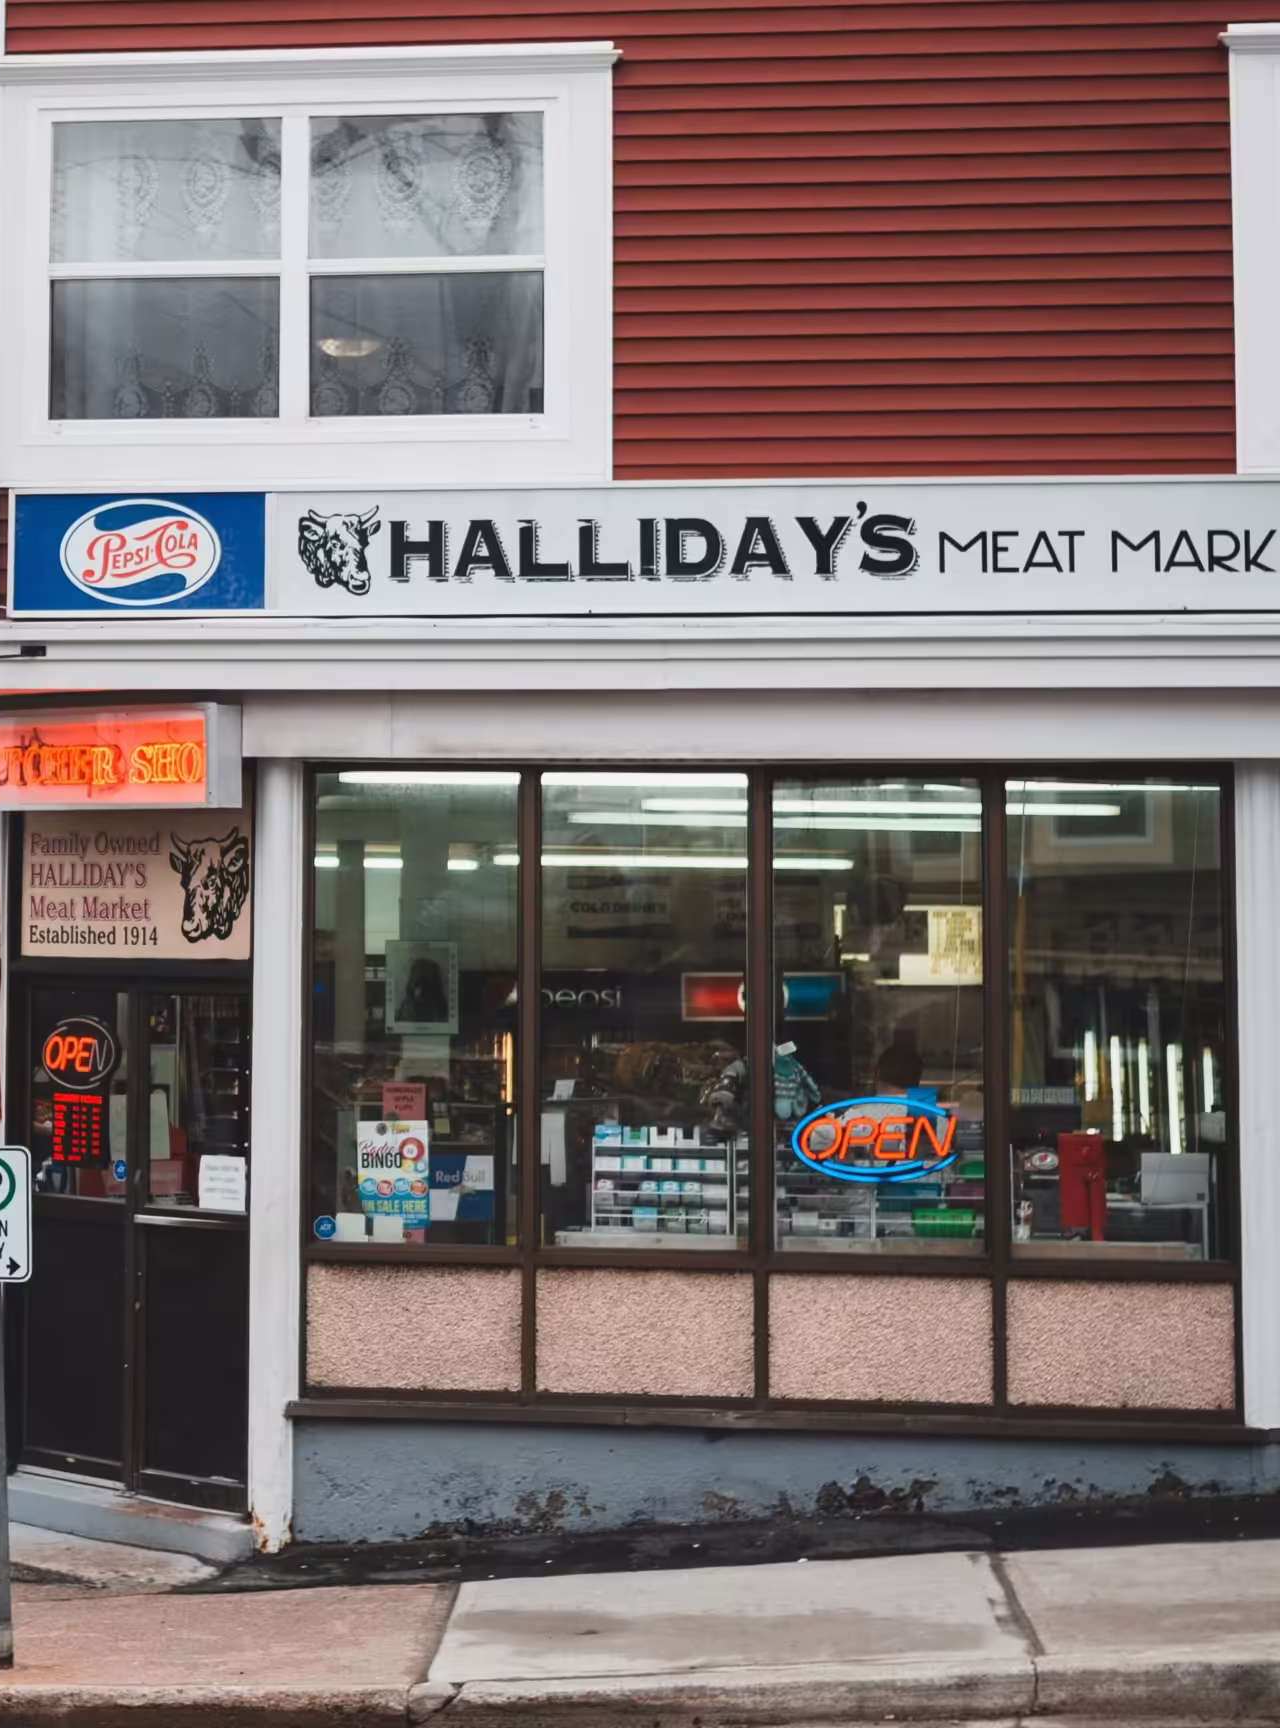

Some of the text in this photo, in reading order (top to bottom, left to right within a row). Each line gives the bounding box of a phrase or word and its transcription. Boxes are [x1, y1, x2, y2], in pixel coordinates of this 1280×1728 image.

[388, 500, 1278, 584] HALLIDAY'S MEAT MARK
[129, 742, 206, 784] SHO
[31, 831, 160, 861] Family Owned
[30, 862, 147, 888] HALLIDAY'S
[30, 896, 151, 920] Meat Market
[29, 925, 158, 946] Established 1914
[45, 1035, 108, 1073] OPEN
[800, 1114, 957, 1161] OPEN
[361, 1152, 403, 1168] BINGO
[435, 1170, 459, 1183] Red
